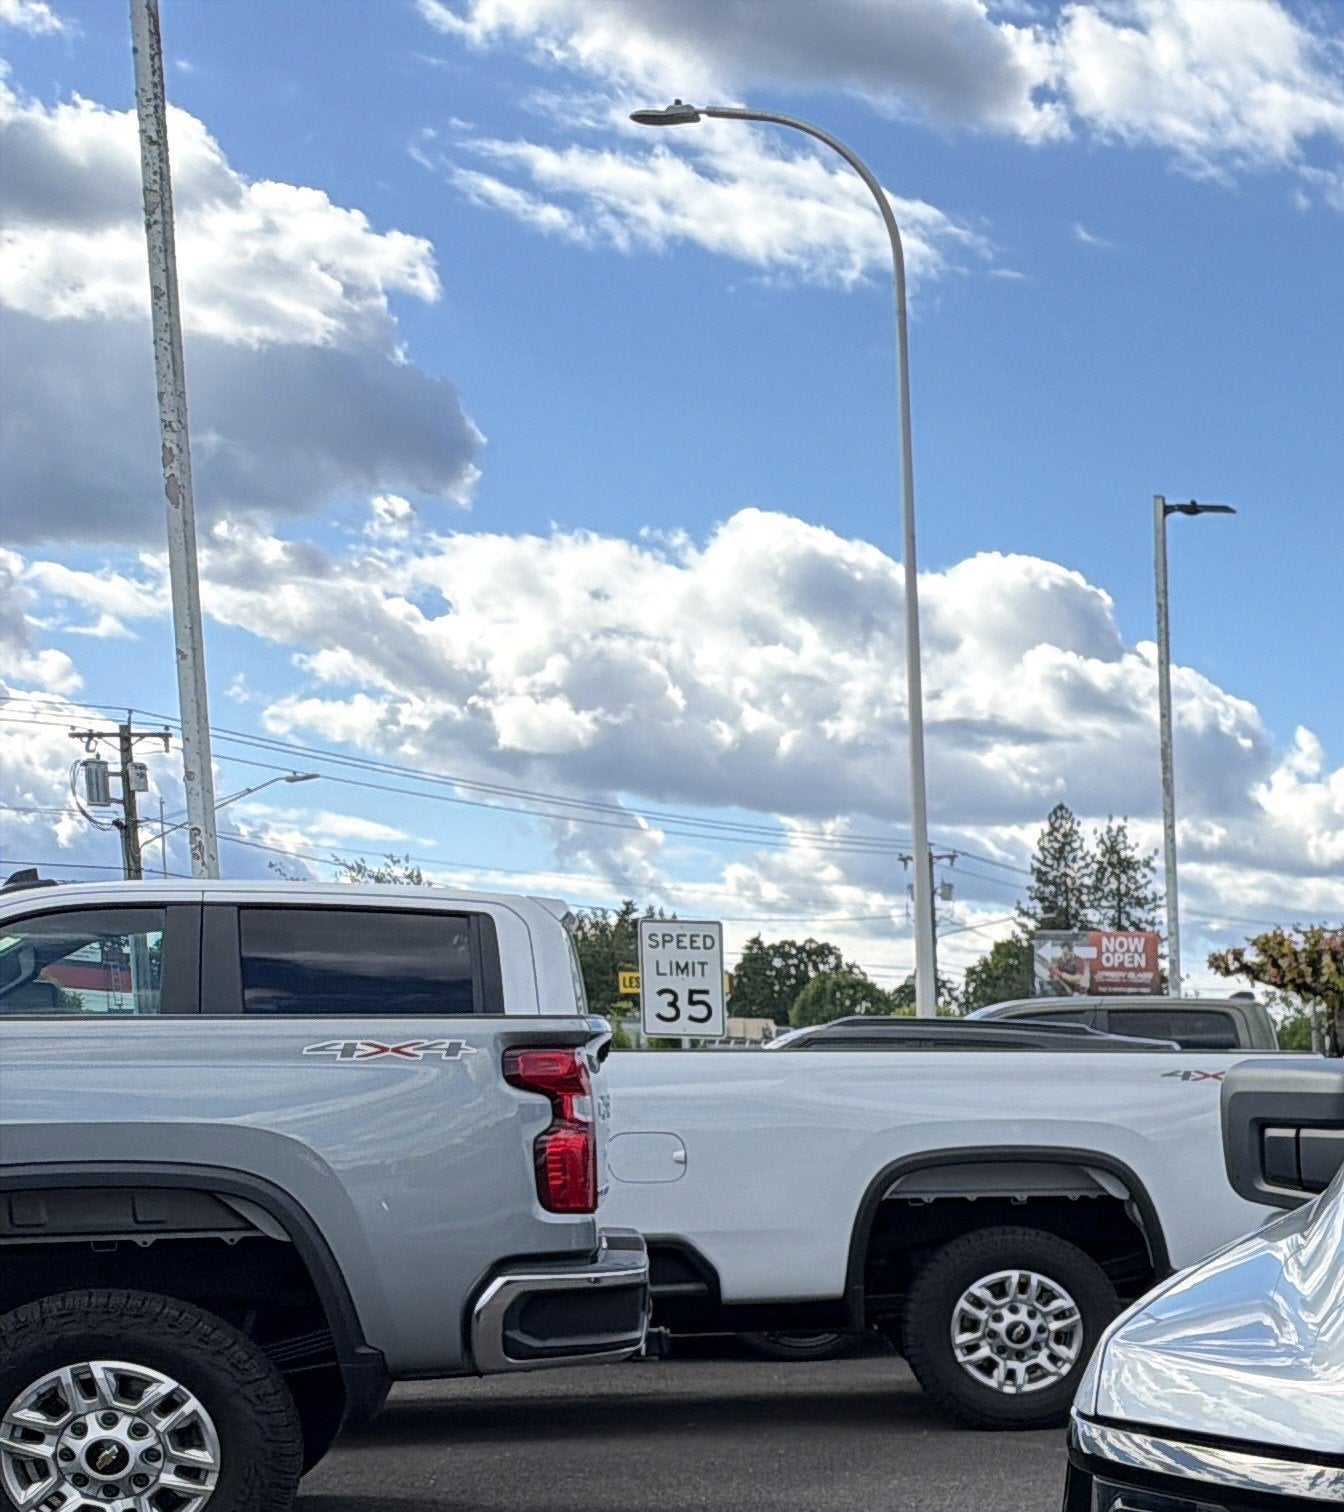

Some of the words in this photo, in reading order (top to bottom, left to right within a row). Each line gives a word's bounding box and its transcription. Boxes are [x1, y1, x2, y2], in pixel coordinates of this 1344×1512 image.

[647, 932, 716, 951] SPEED
[1101, 936, 1146, 953] NOW
[655, 960, 709, 978] LIMIT
[1101, 952, 1147, 969] OPEN
[655, 987, 713, 1023] 35
